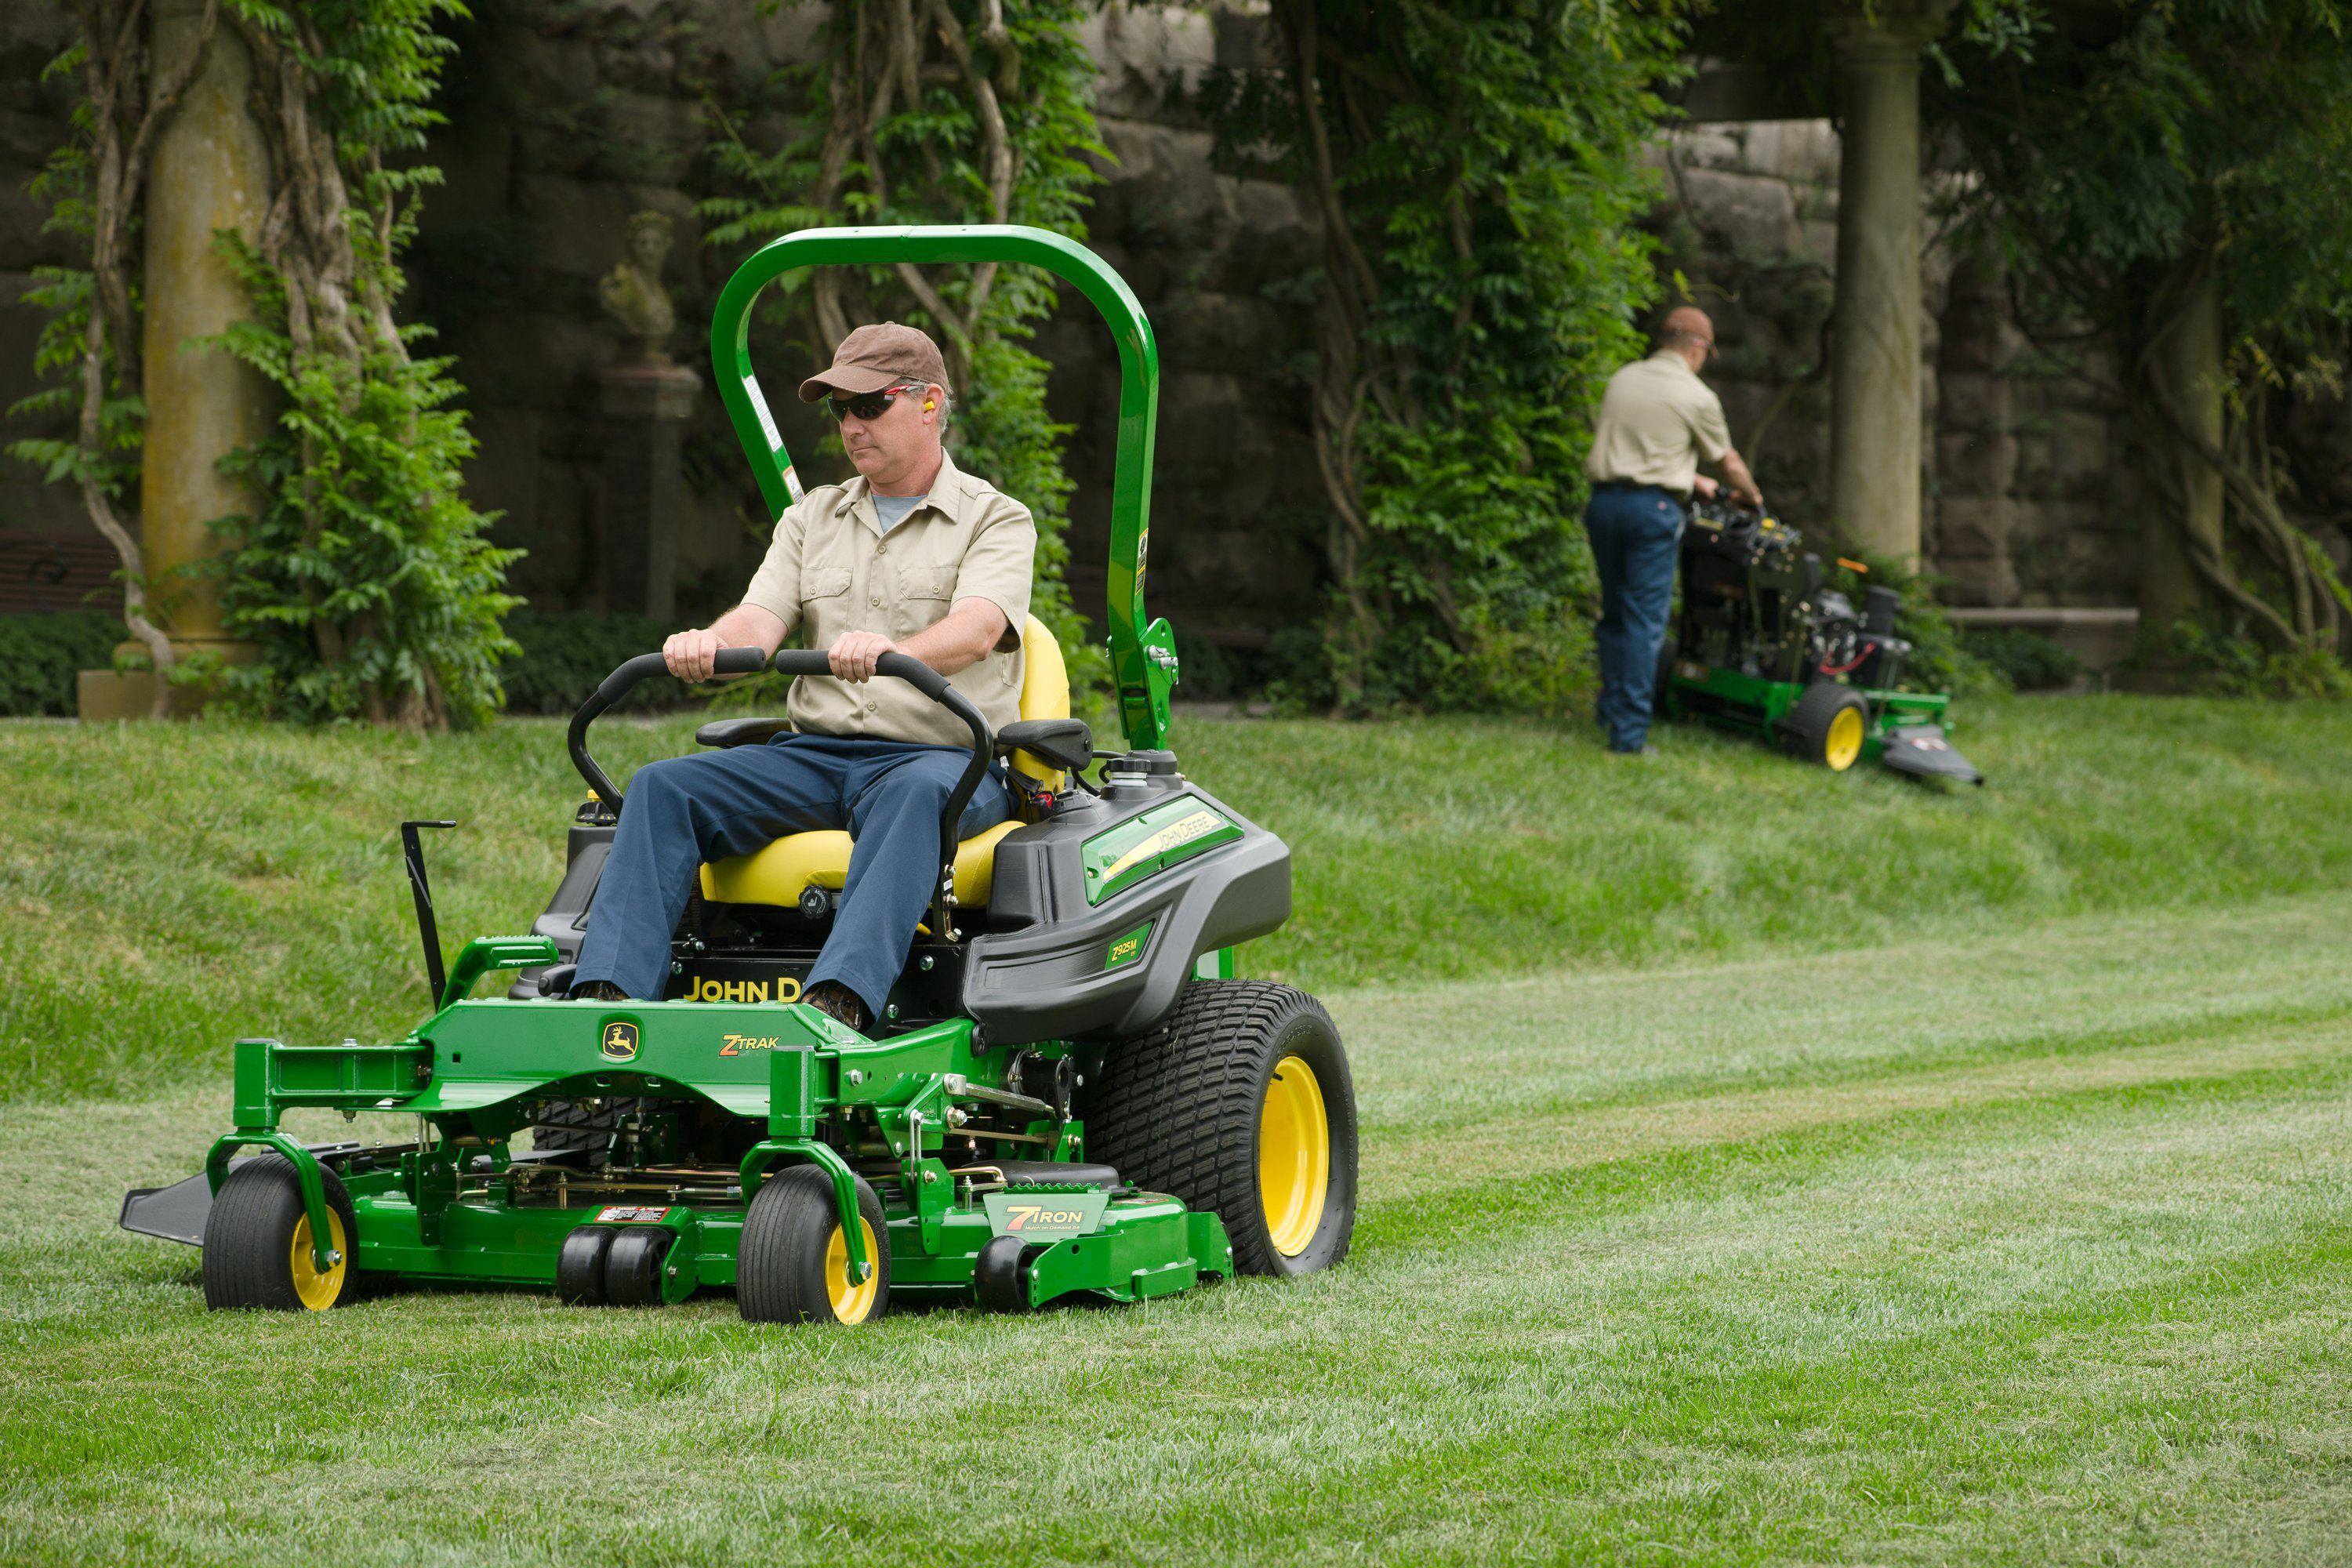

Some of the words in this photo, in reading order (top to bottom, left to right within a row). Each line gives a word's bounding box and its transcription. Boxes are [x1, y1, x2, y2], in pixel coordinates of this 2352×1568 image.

[1159, 828, 1182, 850] JOHN
[1179, 816, 1210, 838] DEERE
[1112, 938, 1138, 962] Z925M
[684, 976, 768, 1003] JOHN
